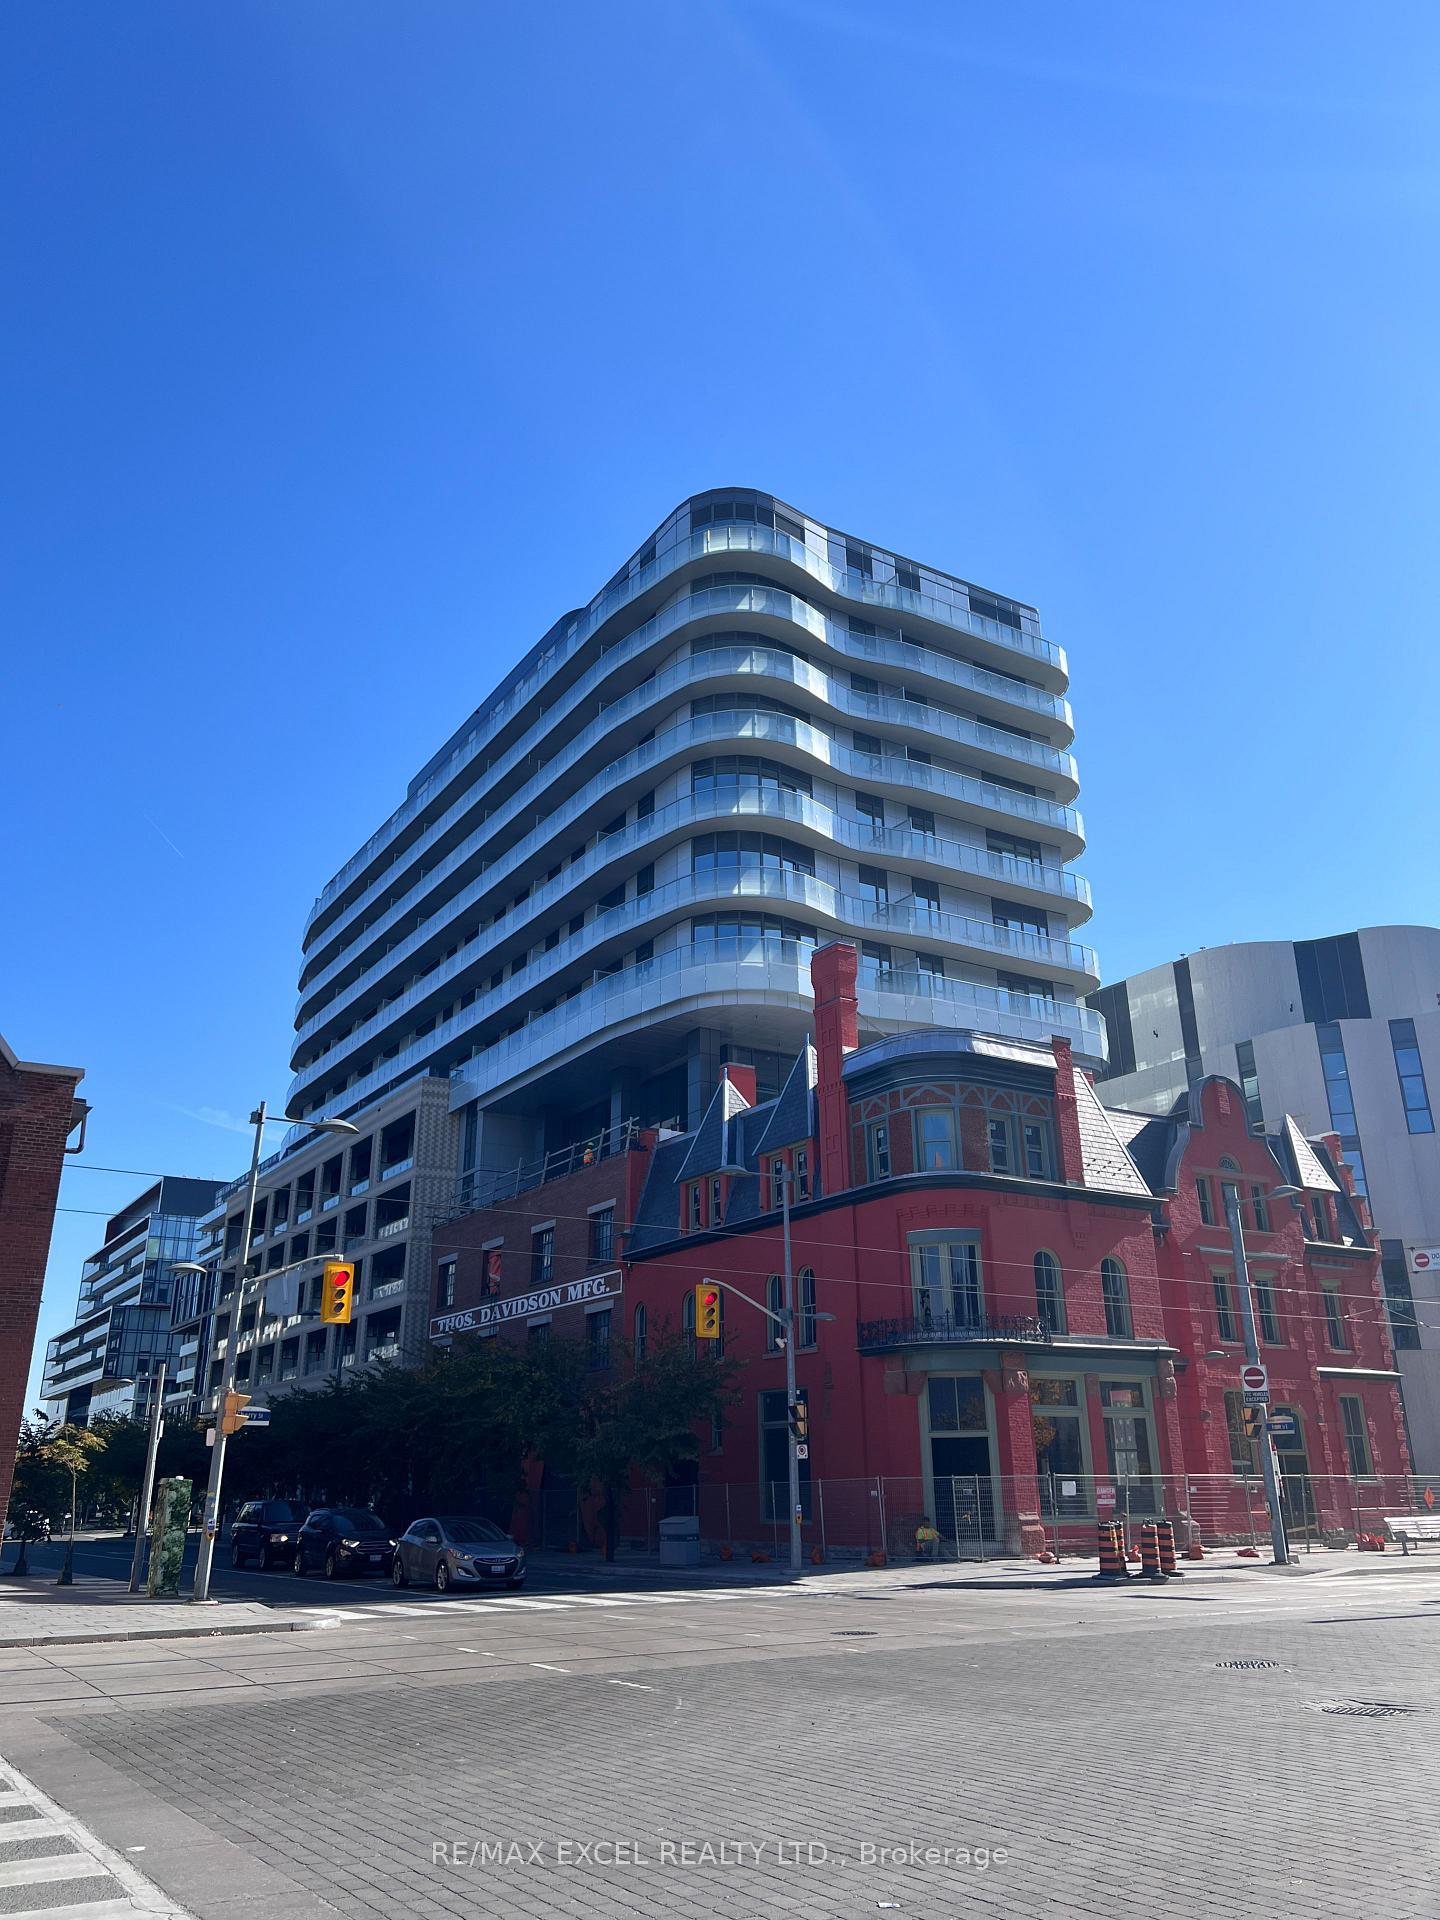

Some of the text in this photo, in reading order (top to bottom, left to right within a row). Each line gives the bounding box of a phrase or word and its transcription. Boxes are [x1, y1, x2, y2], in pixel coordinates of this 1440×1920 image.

[437, 1278, 610, 1333] THOS. DAVIDSON MFG.
